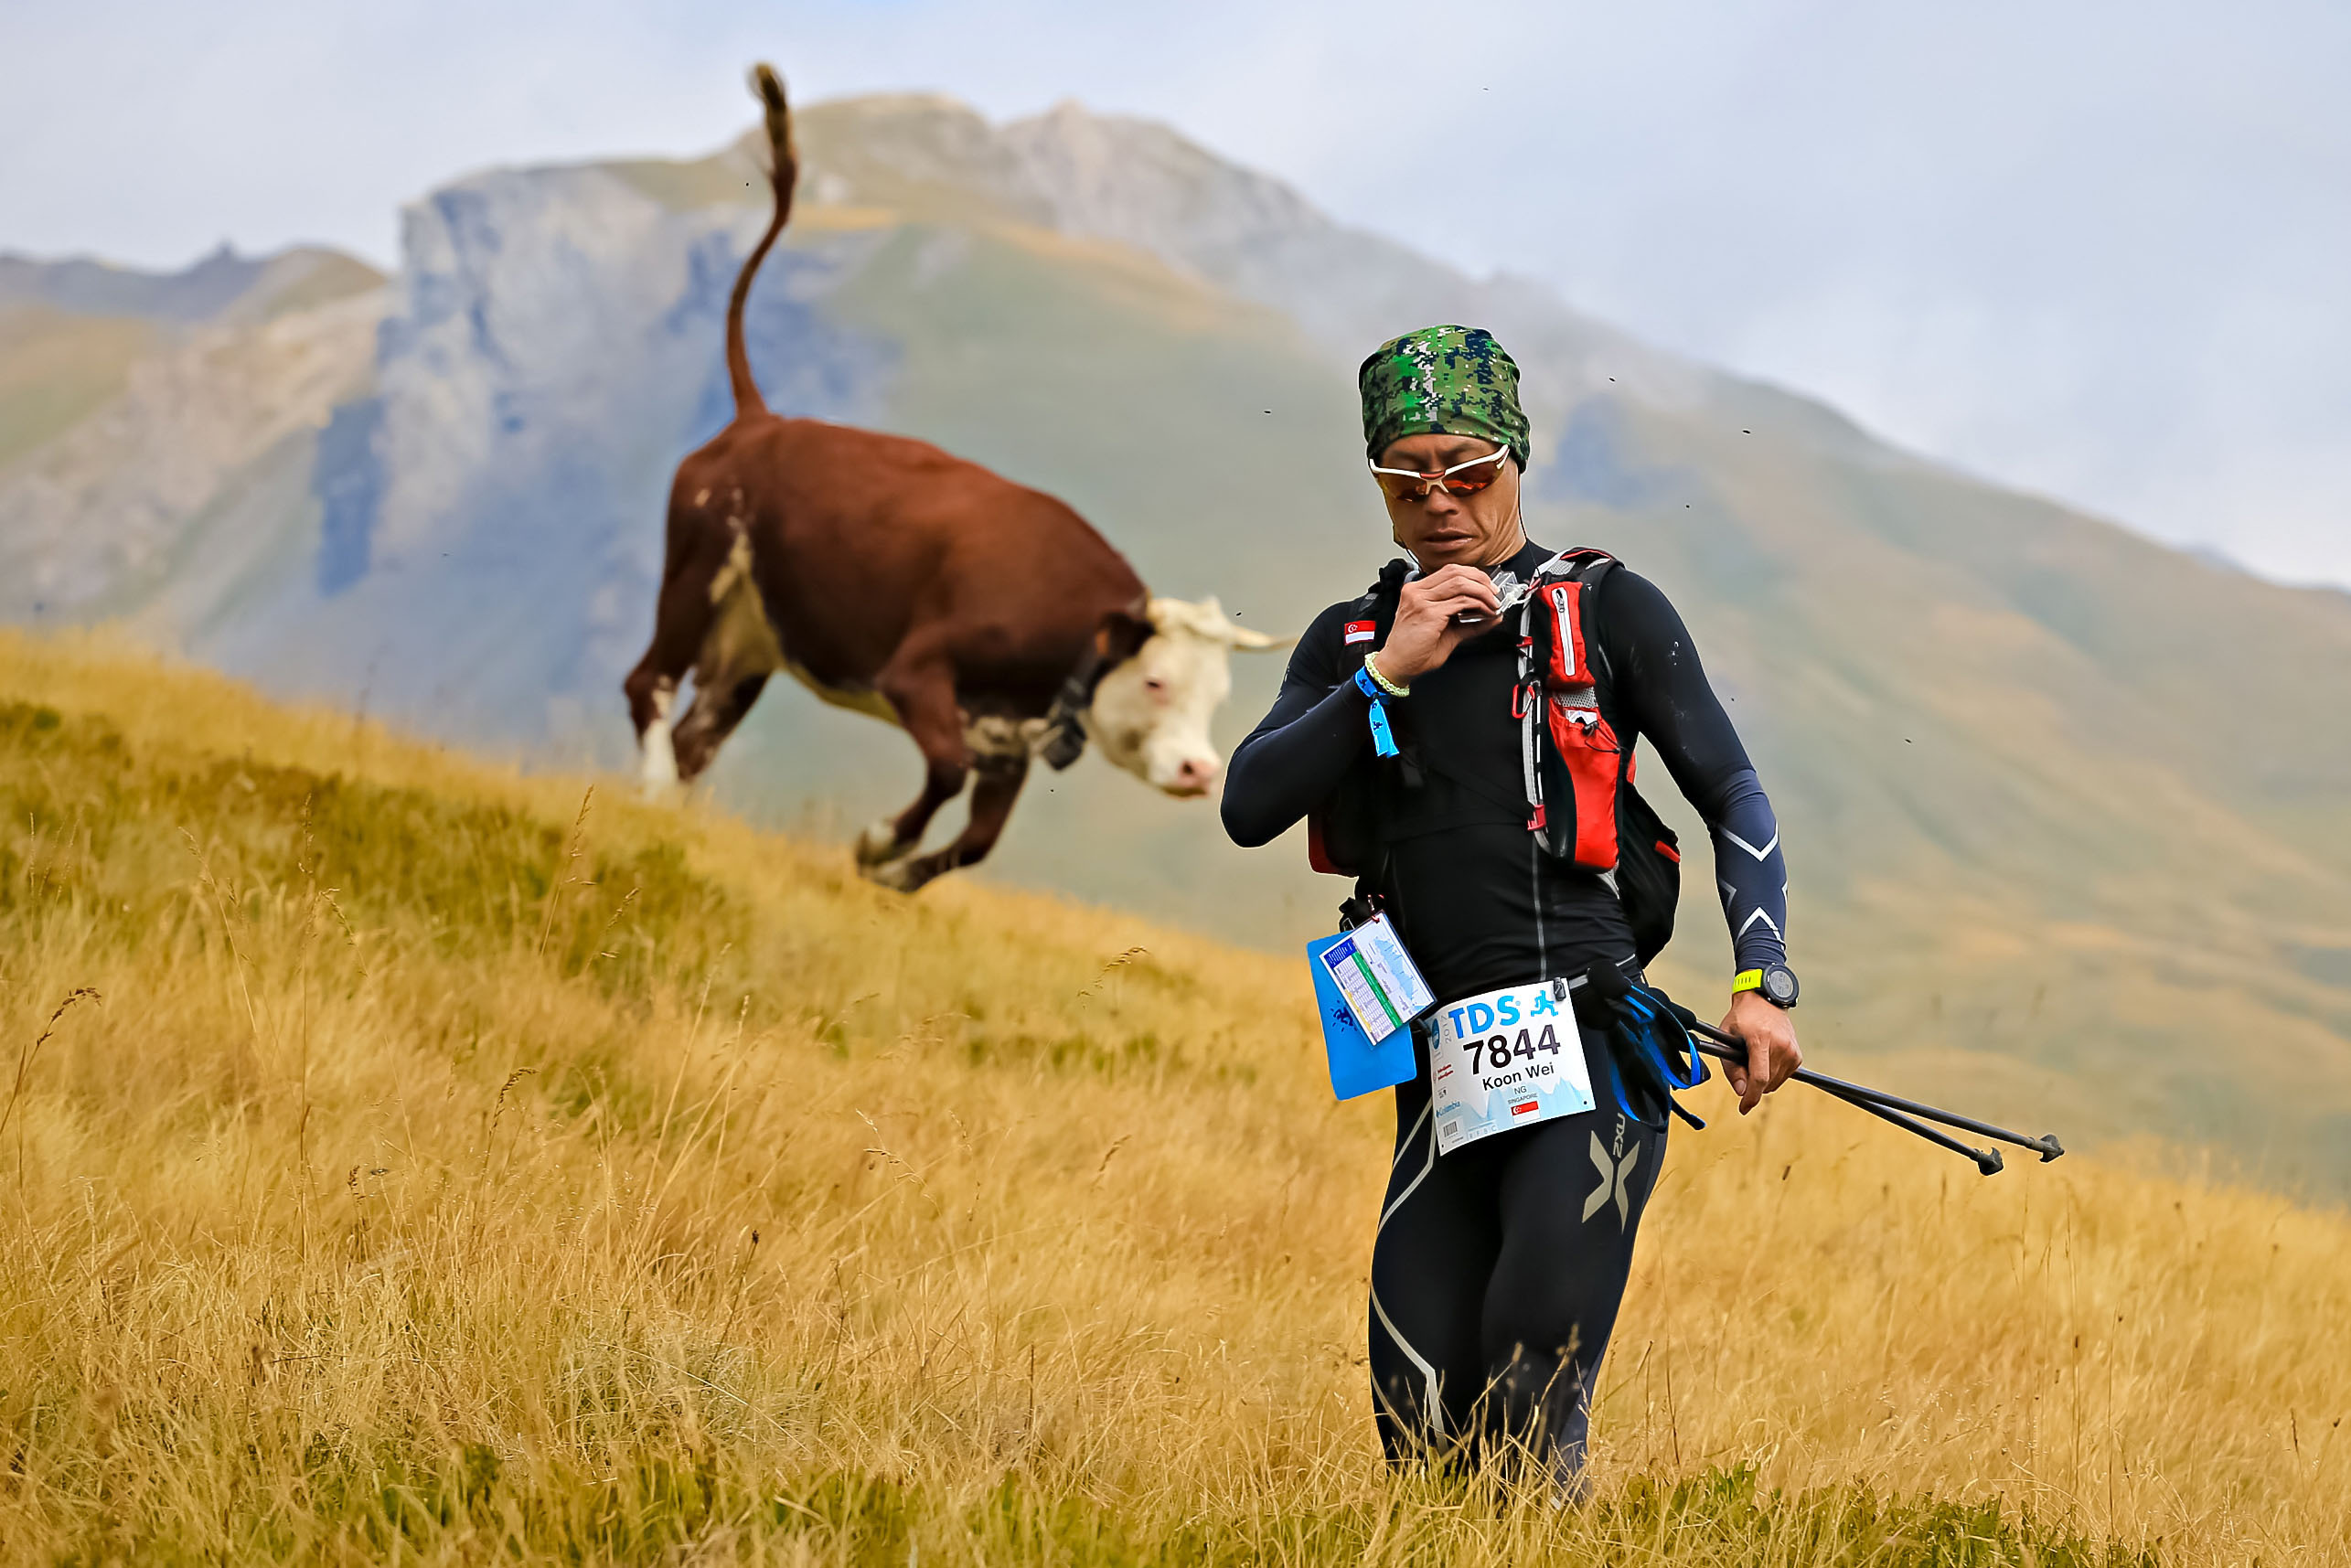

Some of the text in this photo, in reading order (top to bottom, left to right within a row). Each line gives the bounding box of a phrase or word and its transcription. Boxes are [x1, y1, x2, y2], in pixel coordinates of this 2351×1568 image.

[1440, 1015, 1450, 1043] 2017
[1448, 995, 1522, 1040] TDS
[1463, 1024, 1561, 1075] 7844
[1482, 1061, 1555, 1091] Koon Wei
[1514, 1085, 1527, 1095] NG
[1507, 1093, 1538, 1104] SINGAPORE
[1613, 1113, 1626, 1158] 2XU
